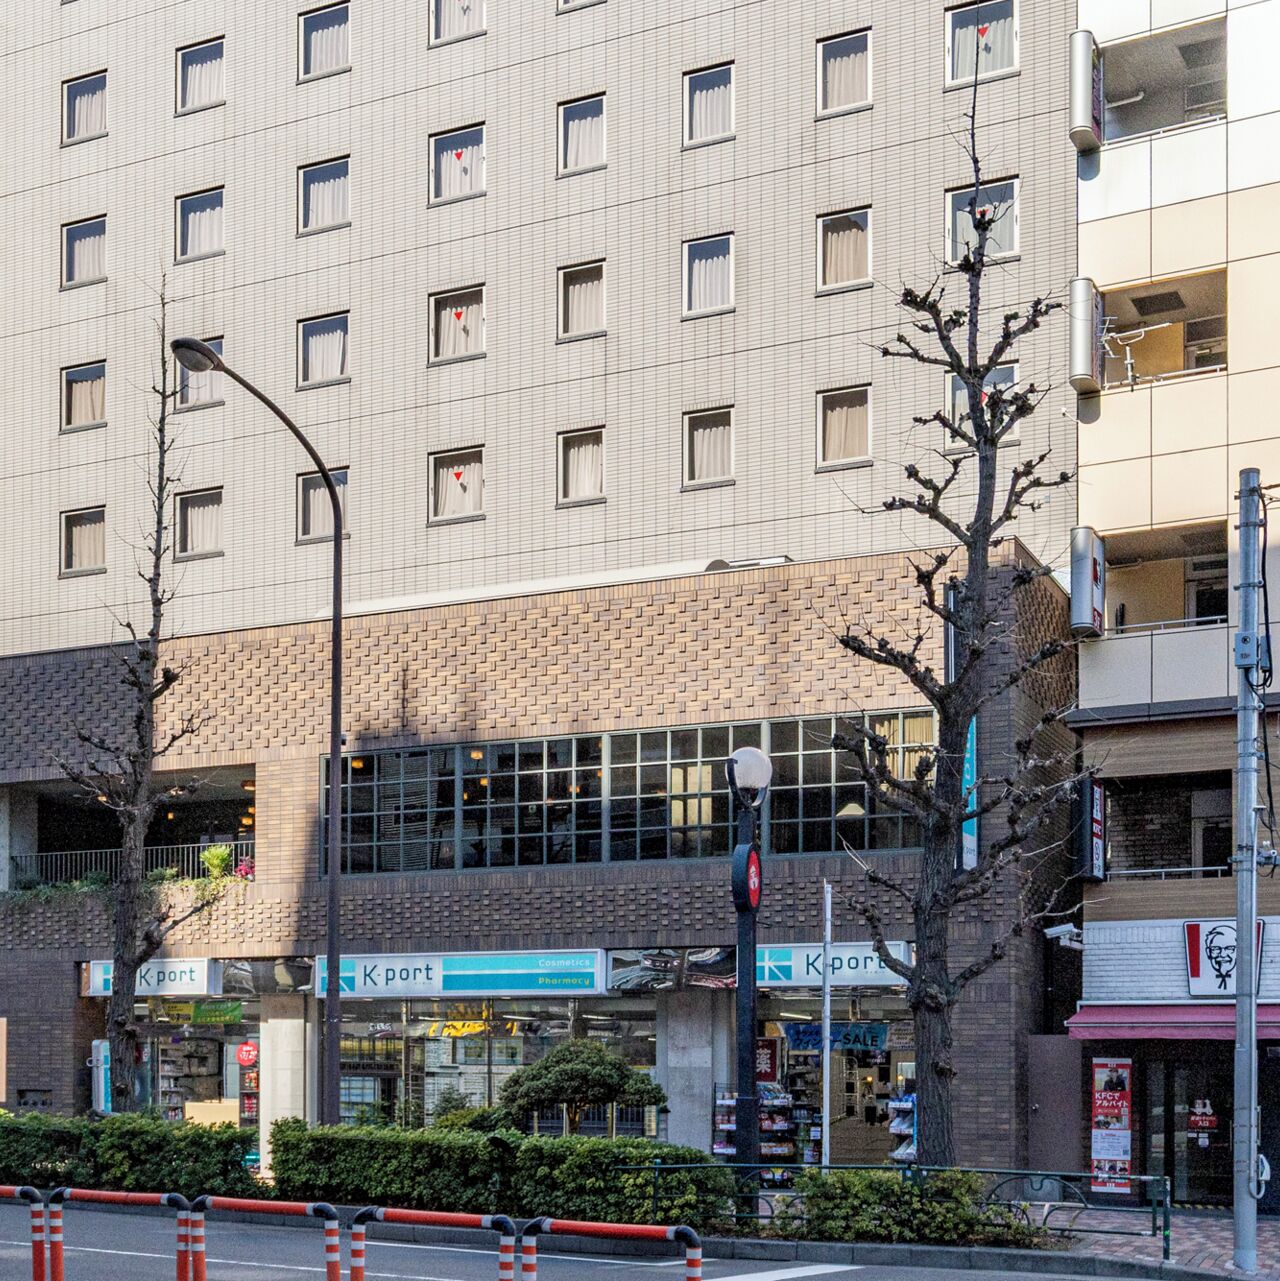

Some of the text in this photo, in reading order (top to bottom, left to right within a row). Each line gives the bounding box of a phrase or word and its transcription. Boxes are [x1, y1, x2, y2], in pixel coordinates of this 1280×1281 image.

[538, 957, 591, 967] Cosmetics
[538, 976, 591, 986] Pharmacy
[1095, 1091, 1121, 1100] KFCで
